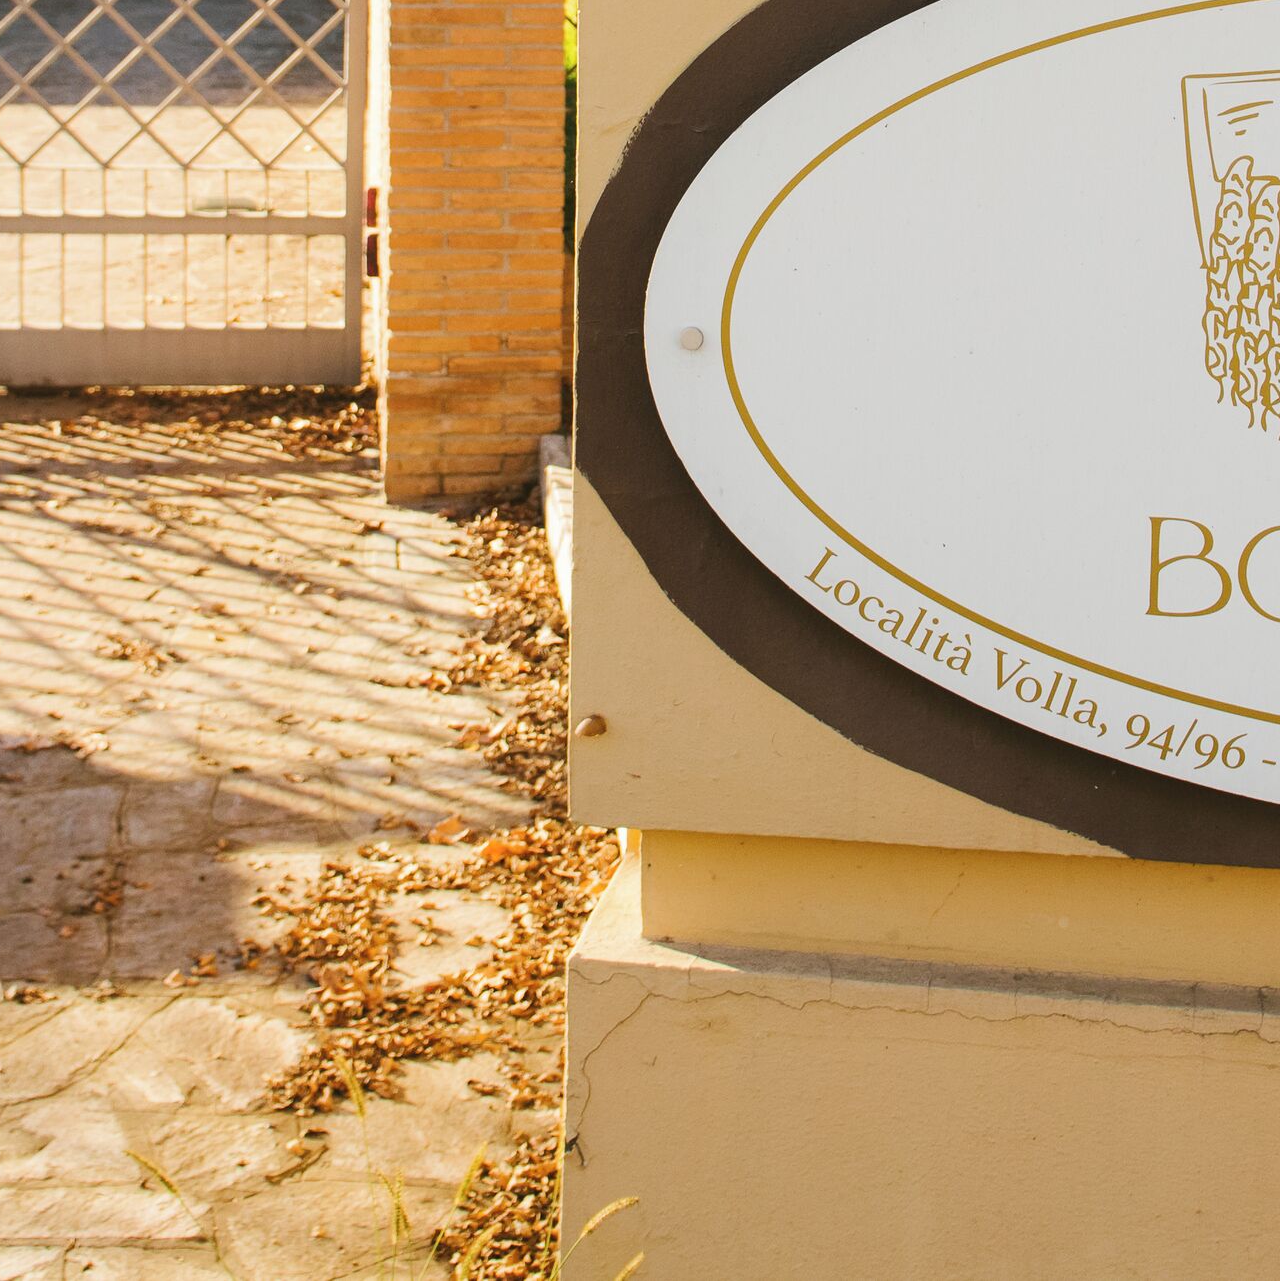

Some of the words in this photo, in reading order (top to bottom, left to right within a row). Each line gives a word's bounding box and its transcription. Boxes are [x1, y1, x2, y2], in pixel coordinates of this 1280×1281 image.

[804, 547, 972, 676] Località
[993, 648, 1109, 738] Volla,
[1124, 714, 1247, 770] 94/96
